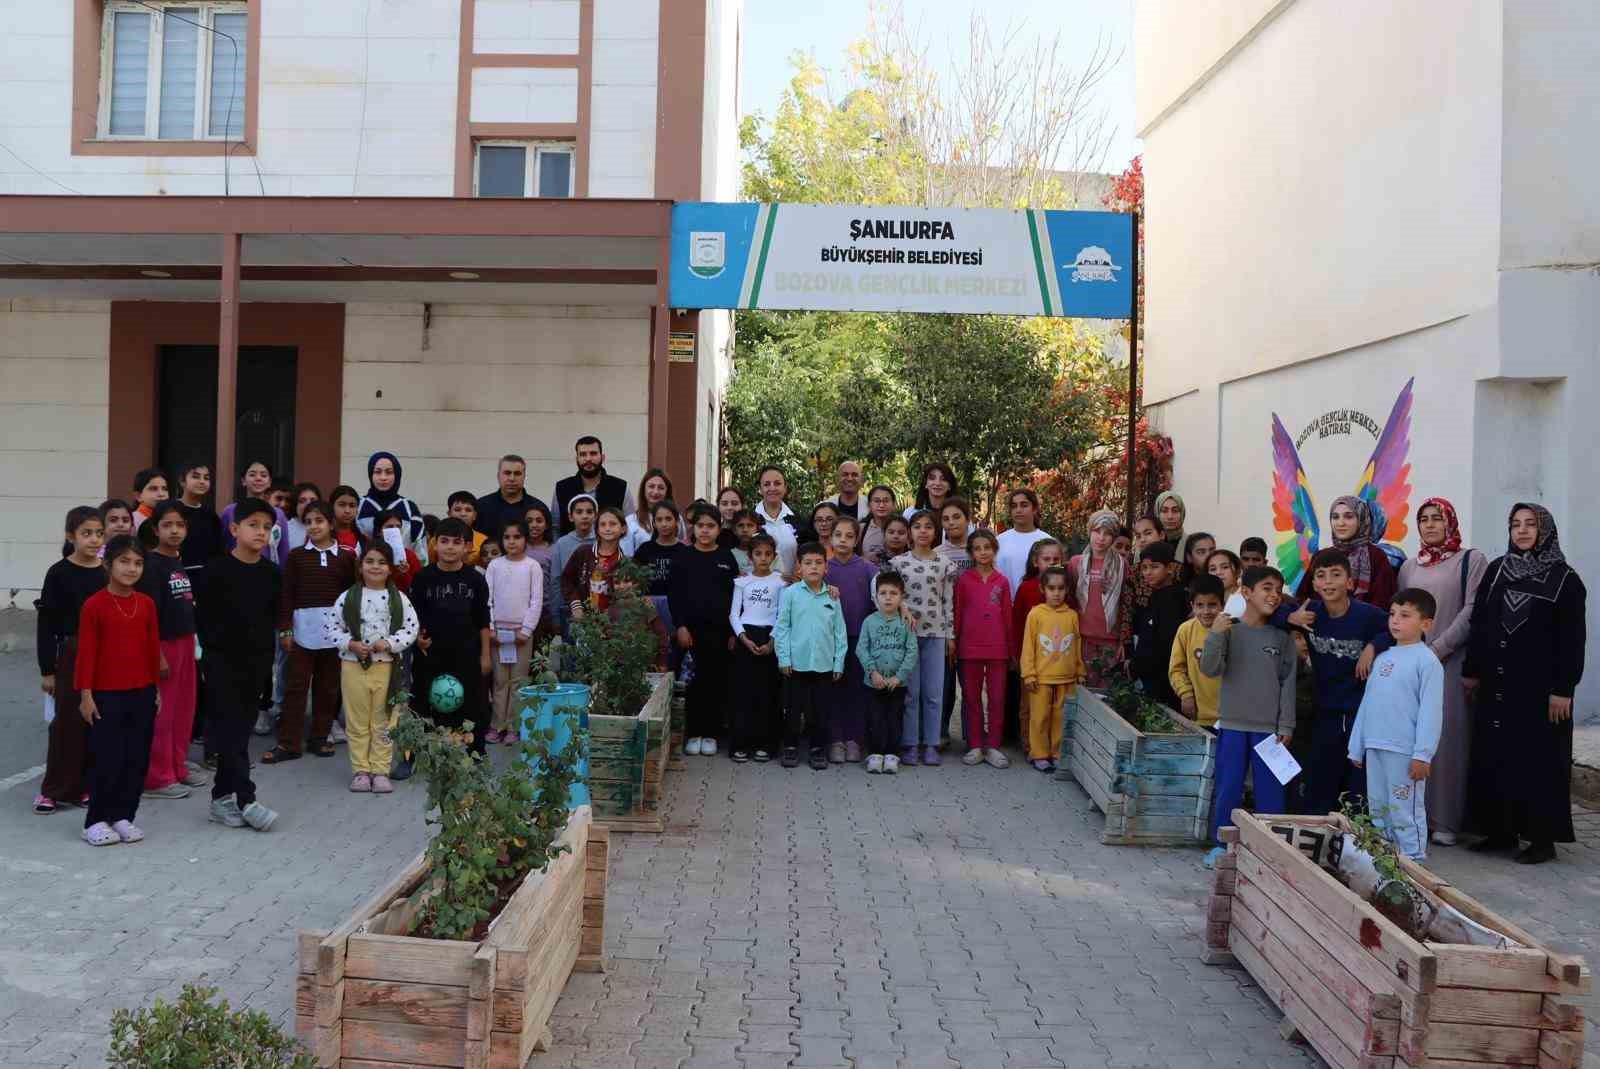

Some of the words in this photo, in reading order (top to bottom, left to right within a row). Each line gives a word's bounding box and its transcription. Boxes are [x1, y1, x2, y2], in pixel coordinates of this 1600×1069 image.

[850, 219, 955, 241] ŞANLIURFA
[821, 246, 905, 265] BÜYÜKŞEHİR
[907, 248, 983, 266] BELEDİYESİ
[775, 271, 852, 293] BOZOVA
[859, 272, 940, 297] GENÇLİK
[944, 274, 1028, 297] MERKEZİ
[1296, 418, 1320, 451] BOZOVA
